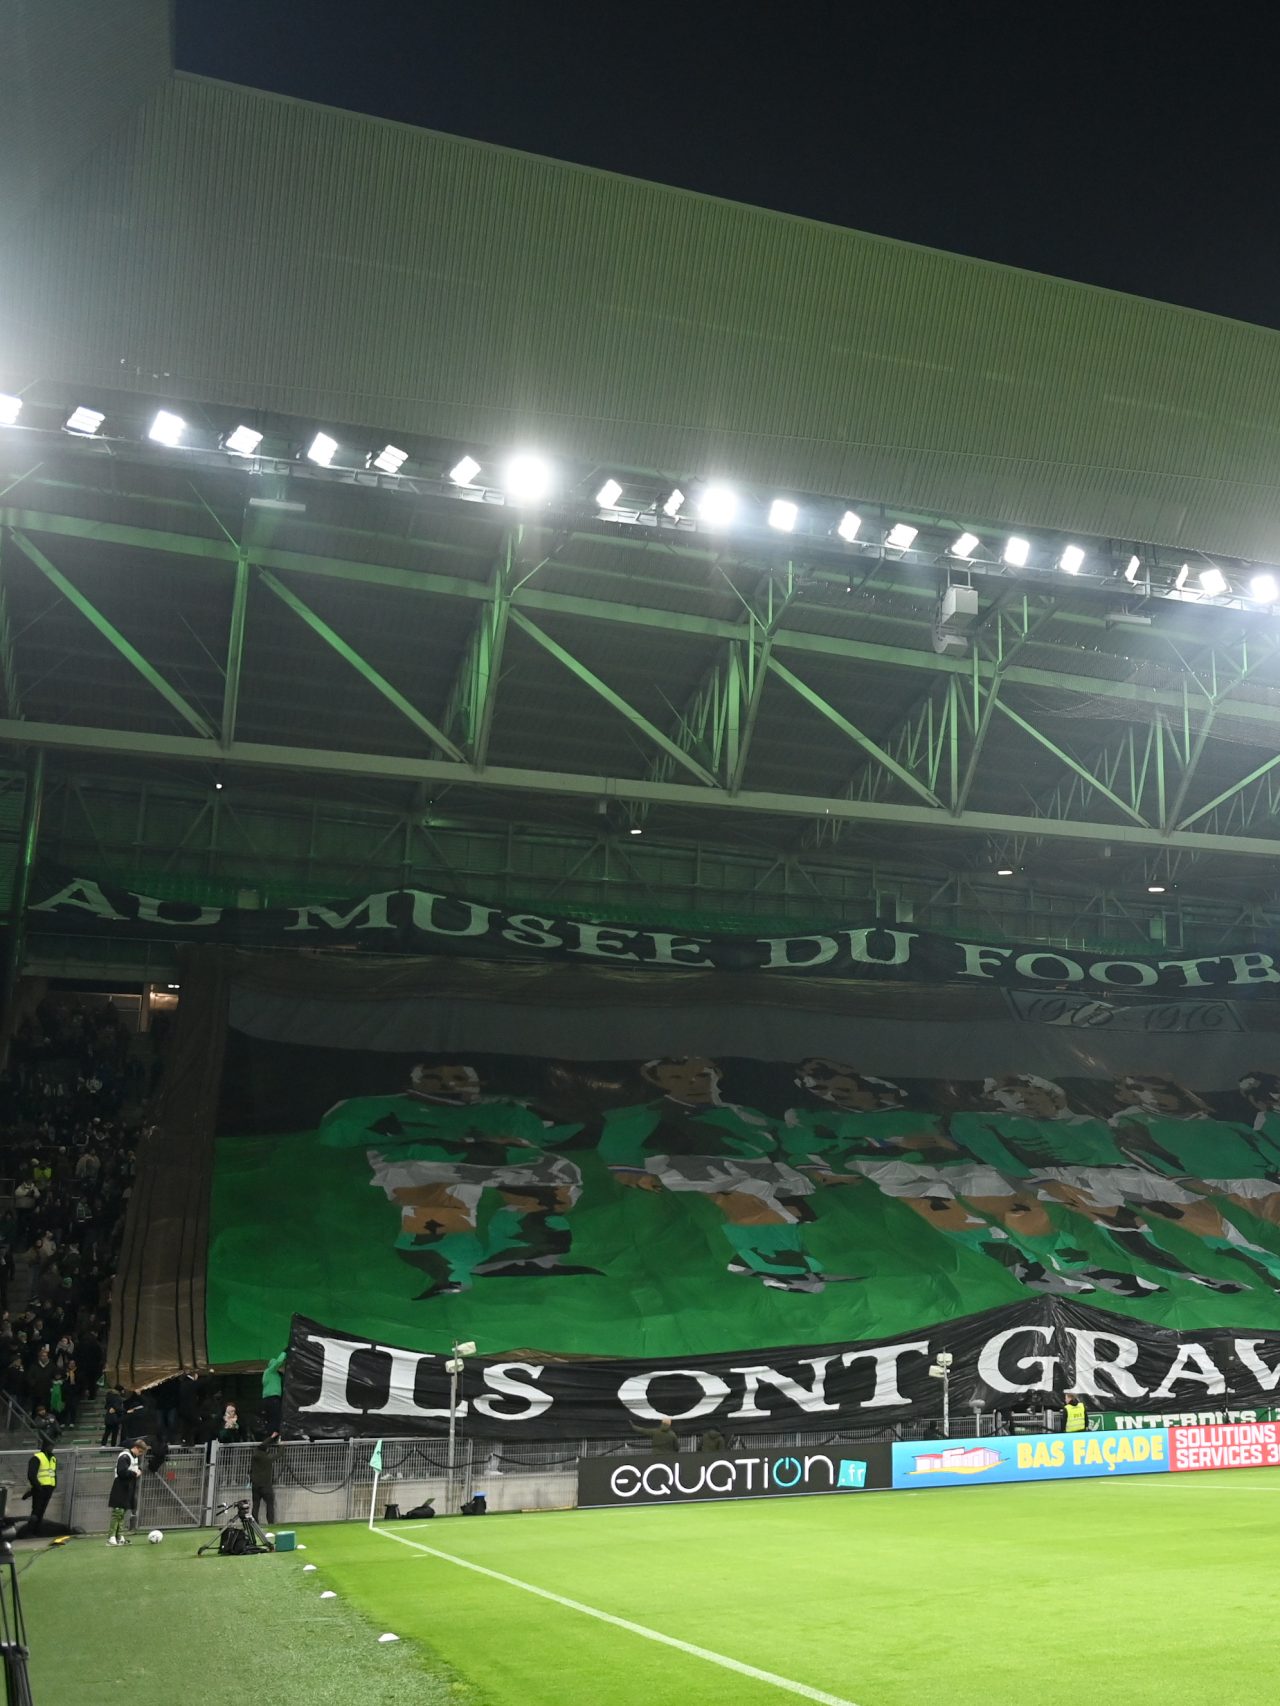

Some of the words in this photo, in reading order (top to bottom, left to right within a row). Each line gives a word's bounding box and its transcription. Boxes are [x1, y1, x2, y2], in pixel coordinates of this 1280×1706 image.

[28, 878, 224, 926] AU
[758, 928, 919, 968] DU
[298, 1334, 555, 1421] ILS
[617, 1340, 931, 1422] ONT
[1017, 1440, 1065, 1469] BAS
[1073, 1435, 1164, 1471] FAÇADE
[1175, 1425, 1276, 1448] SOLUTIONS
[1176, 1444, 1262, 1468] SERVICES
